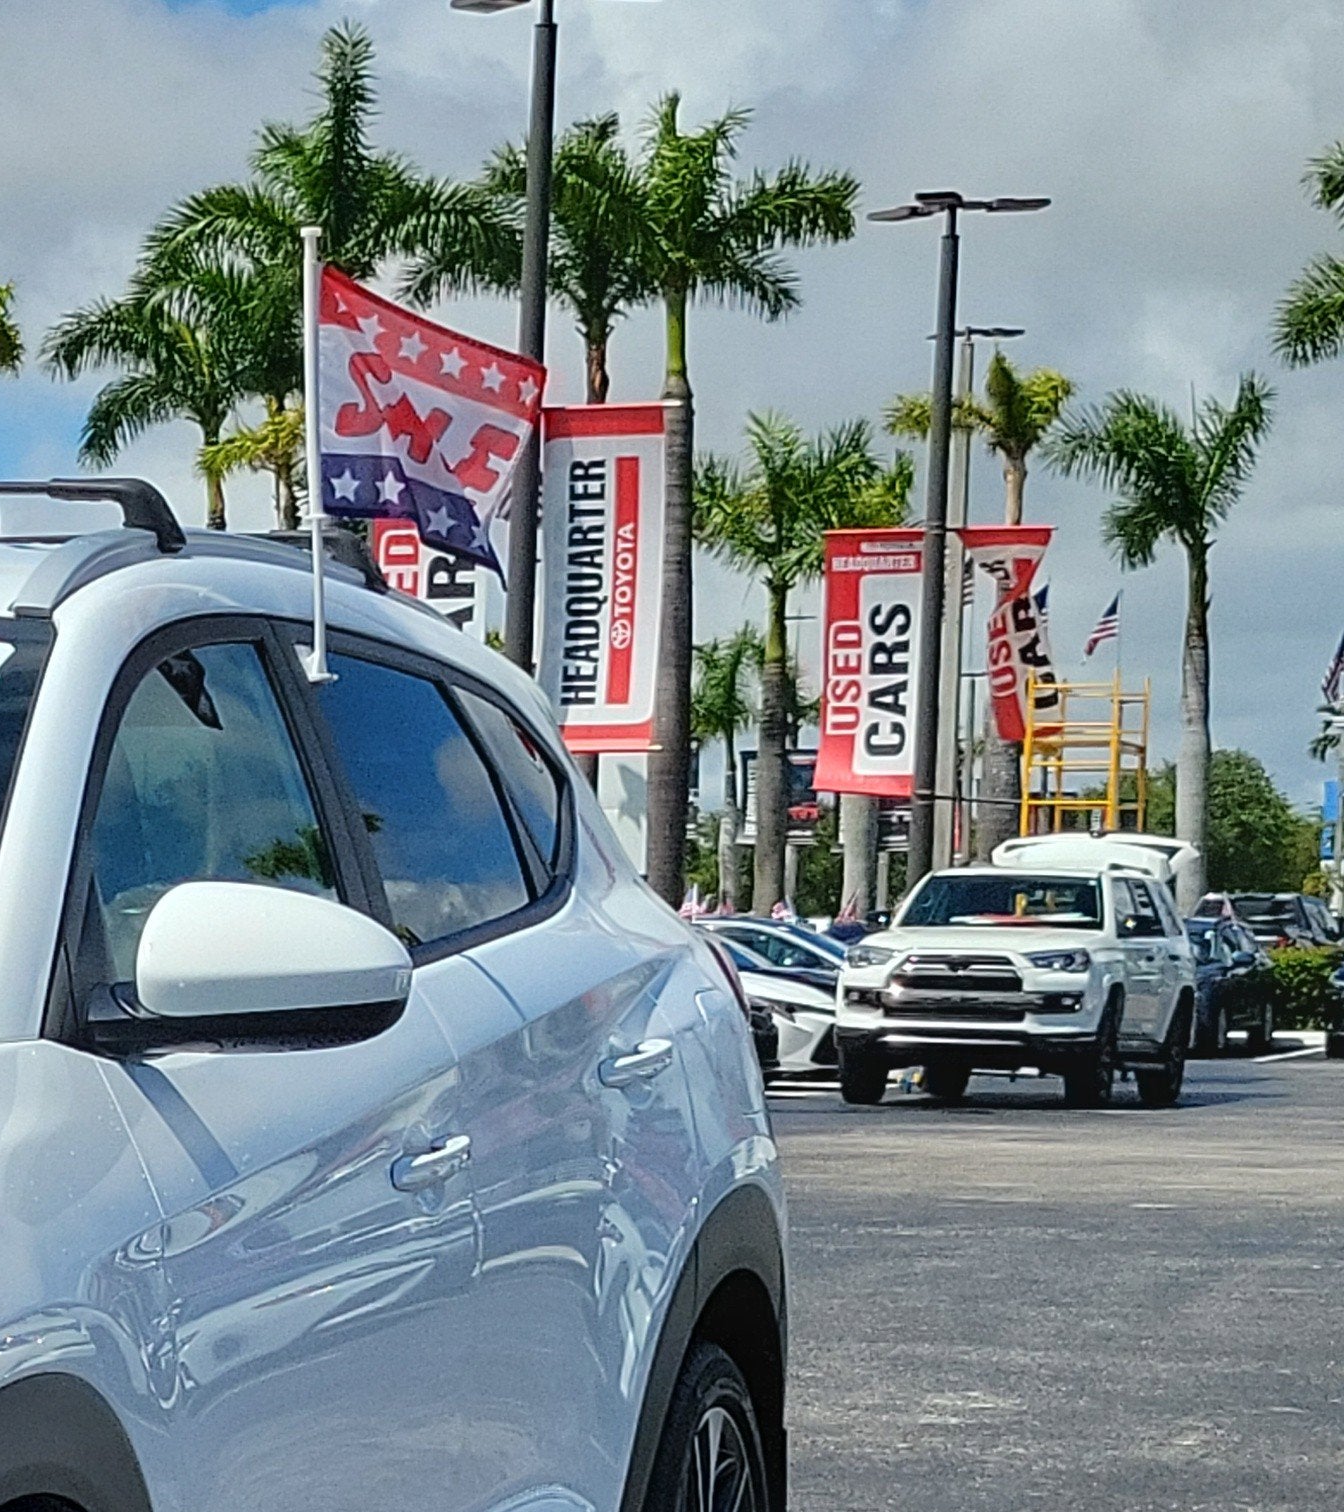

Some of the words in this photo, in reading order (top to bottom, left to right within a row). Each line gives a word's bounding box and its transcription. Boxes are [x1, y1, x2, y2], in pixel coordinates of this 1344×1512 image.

[559, 458, 608, 706] HEADQUARTER
[614, 522, 636, 616] TOYOTA
[828, 624, 862, 731] USED
[865, 603, 912, 757] CARS
[987, 612, 1018, 696] USE
